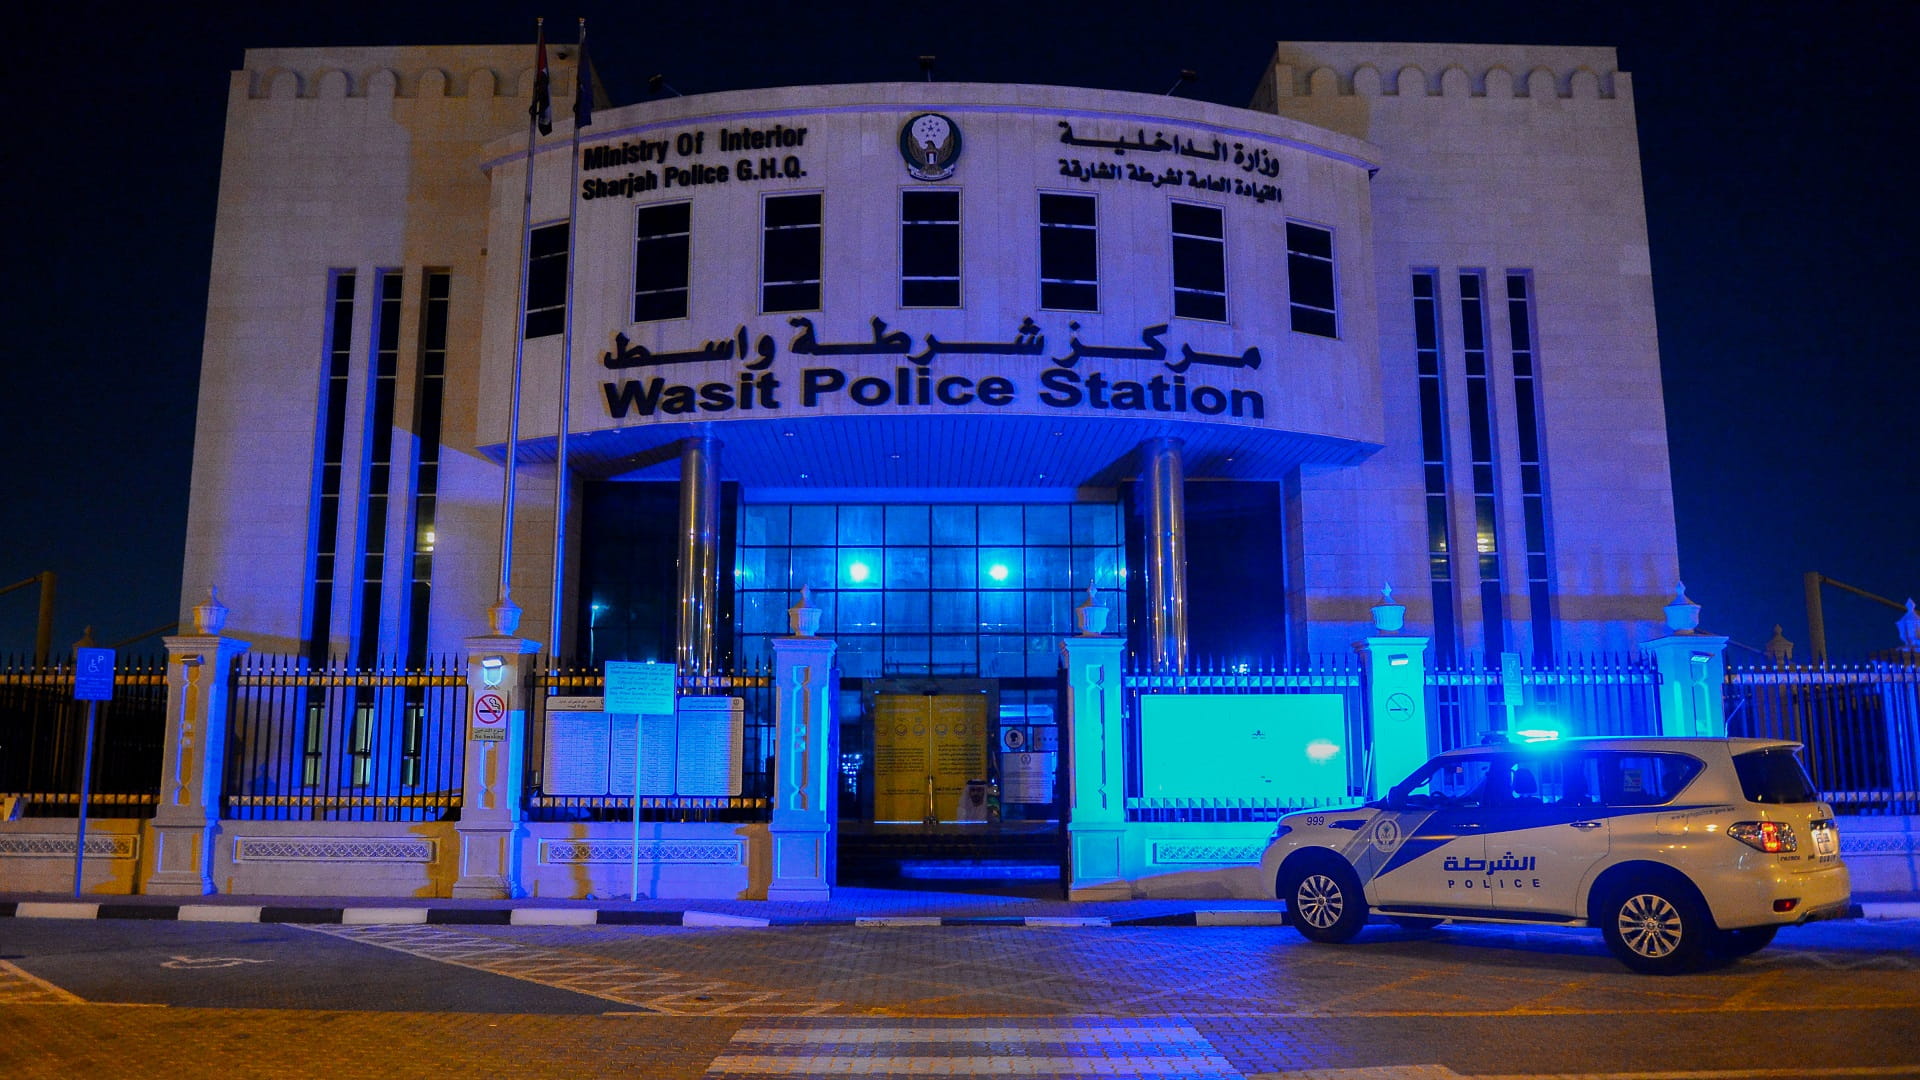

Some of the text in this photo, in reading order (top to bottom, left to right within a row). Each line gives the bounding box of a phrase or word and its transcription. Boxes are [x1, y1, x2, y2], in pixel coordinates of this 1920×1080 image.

[584, 124, 807, 171] Ministry Of Interior
[1058, 121, 1279, 178] وزارة الداخلية
[582, 155, 807, 200] Sharjah Police G.H.Q.
[1058, 159, 1282, 203] القيادة العامة لشرطة الشارقة
[603, 315, 1261, 373] مركز شرطة واسط
[602, 366, 1265, 420] Wasit Police Station
[1306, 816, 1325, 826] 999
[1443, 851, 1536, 875] الشرطة
[1448, 878, 1541, 888] POLICE
